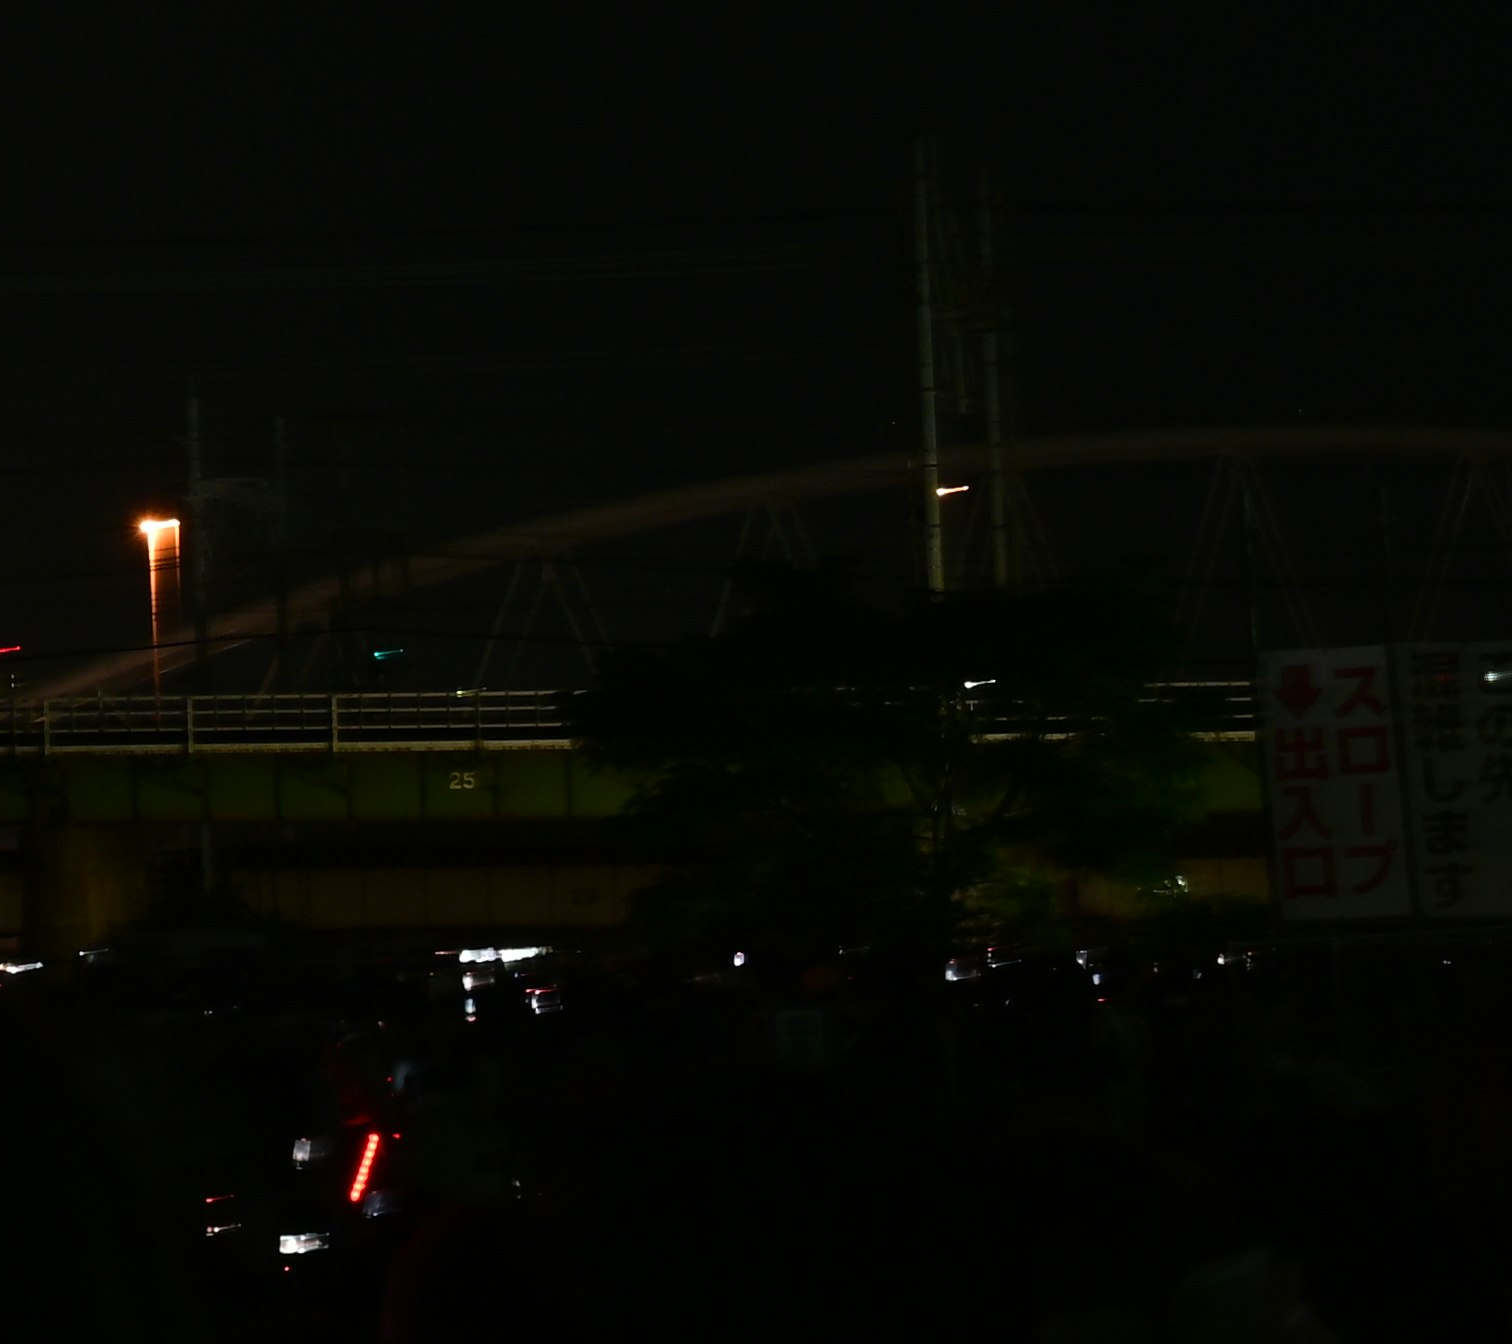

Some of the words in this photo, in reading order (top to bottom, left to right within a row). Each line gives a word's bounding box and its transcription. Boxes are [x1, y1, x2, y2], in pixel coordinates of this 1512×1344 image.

[449, 771, 476, 789] 25
[1274, 726, 1338, 900] 出入口
[1333, 667, 1398, 895] スロープ
